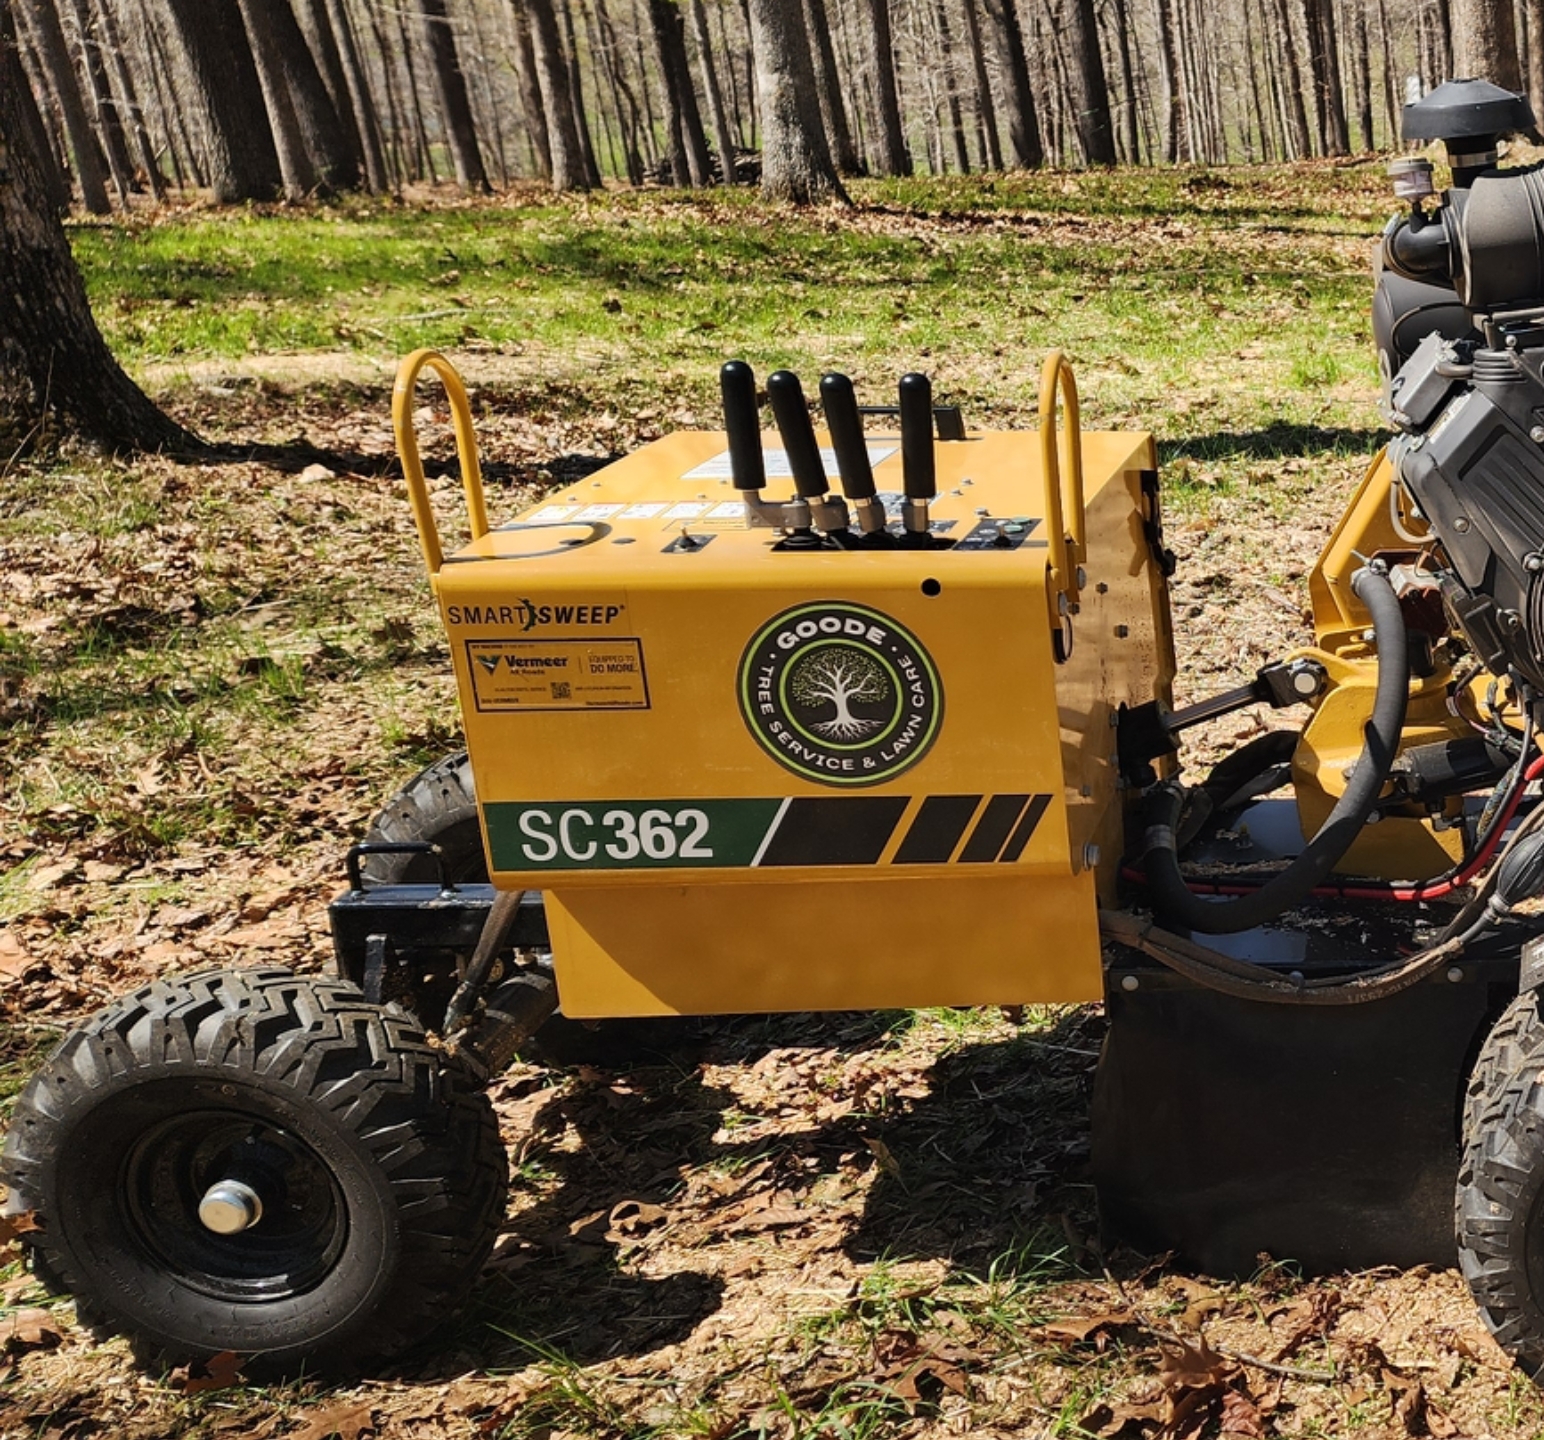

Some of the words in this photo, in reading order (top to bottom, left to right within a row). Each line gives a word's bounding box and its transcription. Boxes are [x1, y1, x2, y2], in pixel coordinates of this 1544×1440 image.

[447, 605, 526, 625] SMART
[776, 616, 888, 650] GOODE
[504, 655, 569, 668] Vermeer
[590, 664, 605, 674] DO
[897, 654, 926, 709] CARE
[757, 665, 775, 715] TREE
[768, 720, 855, 771] SERVICE
[880, 714, 923, 762] LAWN
[862, 756, 877, 769] &
[518, 808, 714, 862] SC362
